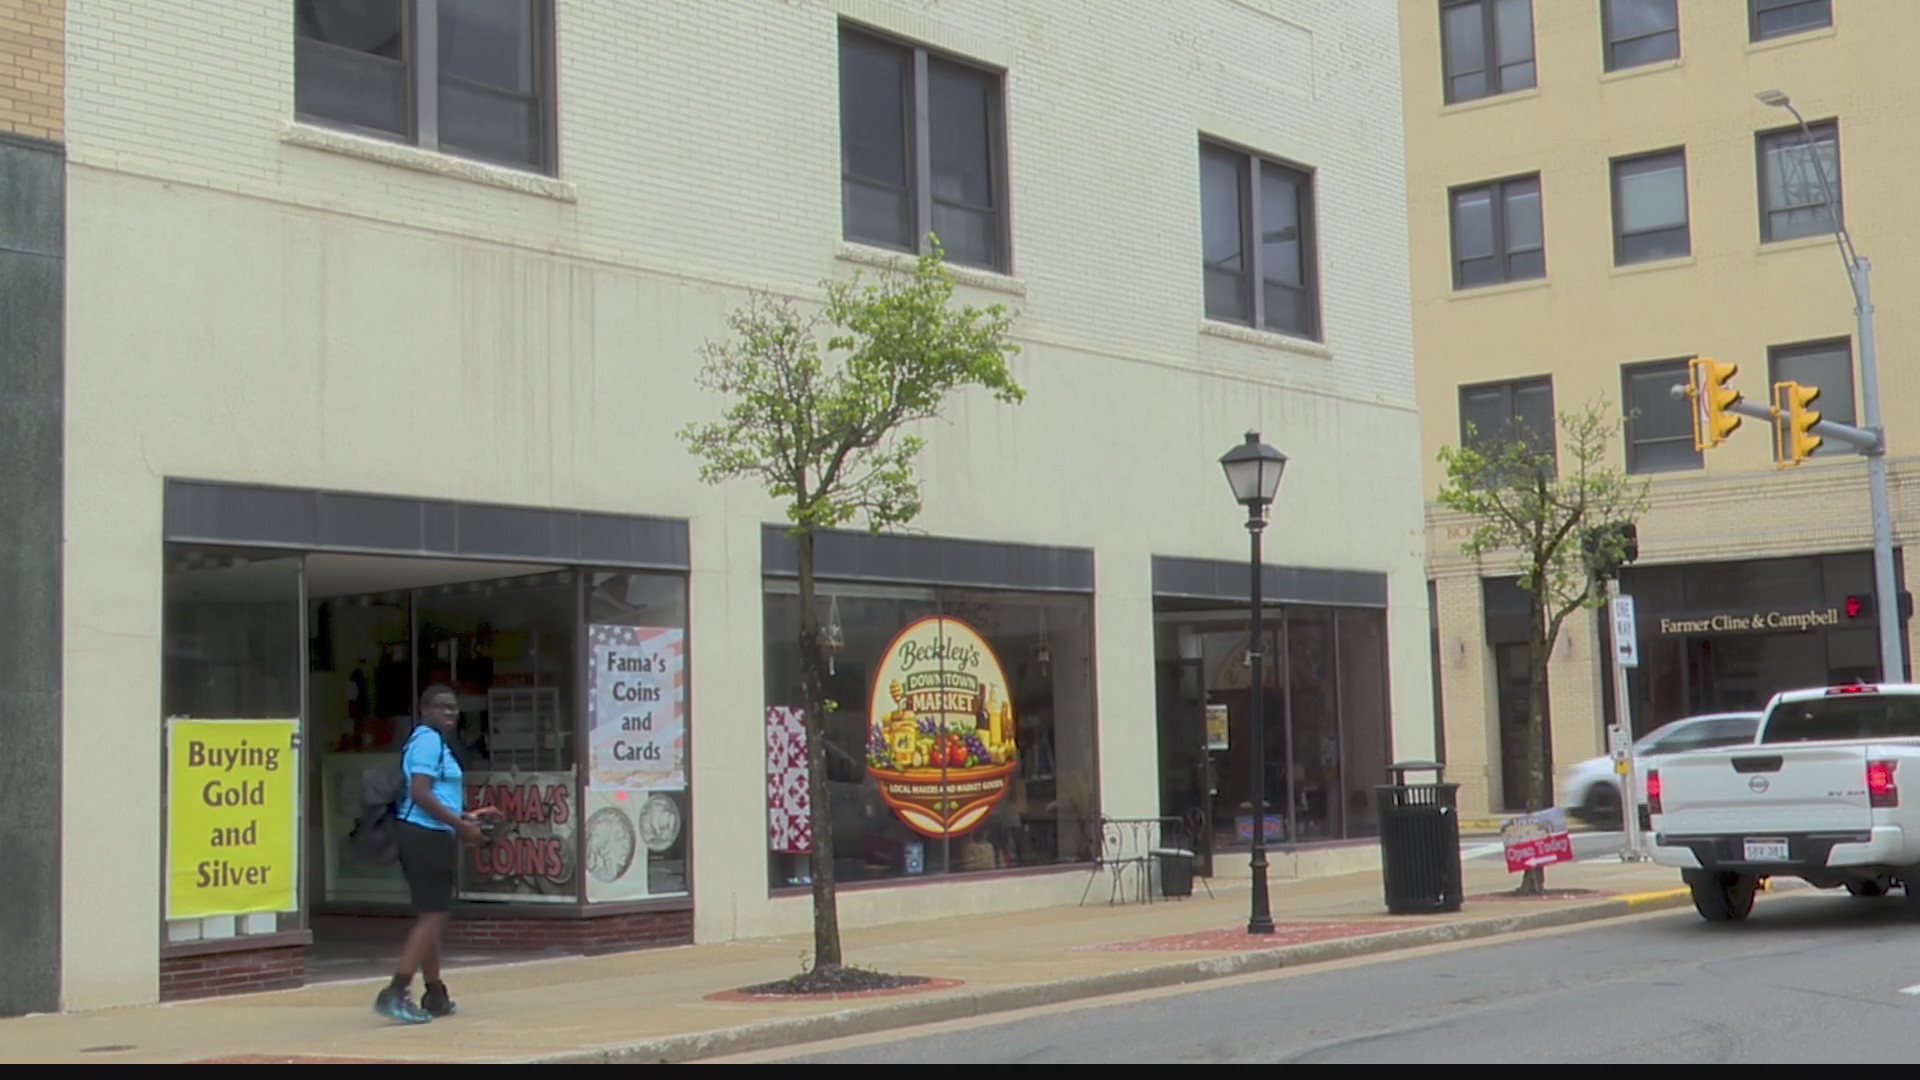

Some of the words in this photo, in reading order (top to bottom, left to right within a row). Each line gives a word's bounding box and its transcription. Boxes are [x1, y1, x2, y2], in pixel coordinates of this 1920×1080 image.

[1616, 601, 1630, 618] ONE
[1660, 618, 1710, 634] Farmer
[1711, 614, 1749, 631] Cline
[1752, 613, 1764, 628] &
[1767, 608, 1838, 630] Campbell
[1618, 620, 1631, 635] WAY
[607, 651, 666, 673] Fama's
[898, 636, 980, 672] Beckley's
[612, 681, 660, 702] Coins
[910, 673, 976, 689] DOWNTOWN
[912, 692, 974, 712] MARKET
[621, 712, 652, 731] and
[188, 739, 281, 772] Buying
[613, 740, 660, 761] Cards
[202, 780, 265, 807] Gold
[889, 783, 911, 794] LOCAL
[957, 782, 981, 792] MARKET
[466, 784, 569, 824] FAMA'S
[210, 819, 257, 847] and
[472, 837, 561, 878] COINS
[1507, 846, 1535, 863] Open
[1534, 838, 1568, 855] Today
[196, 860, 271, 888] Silver
